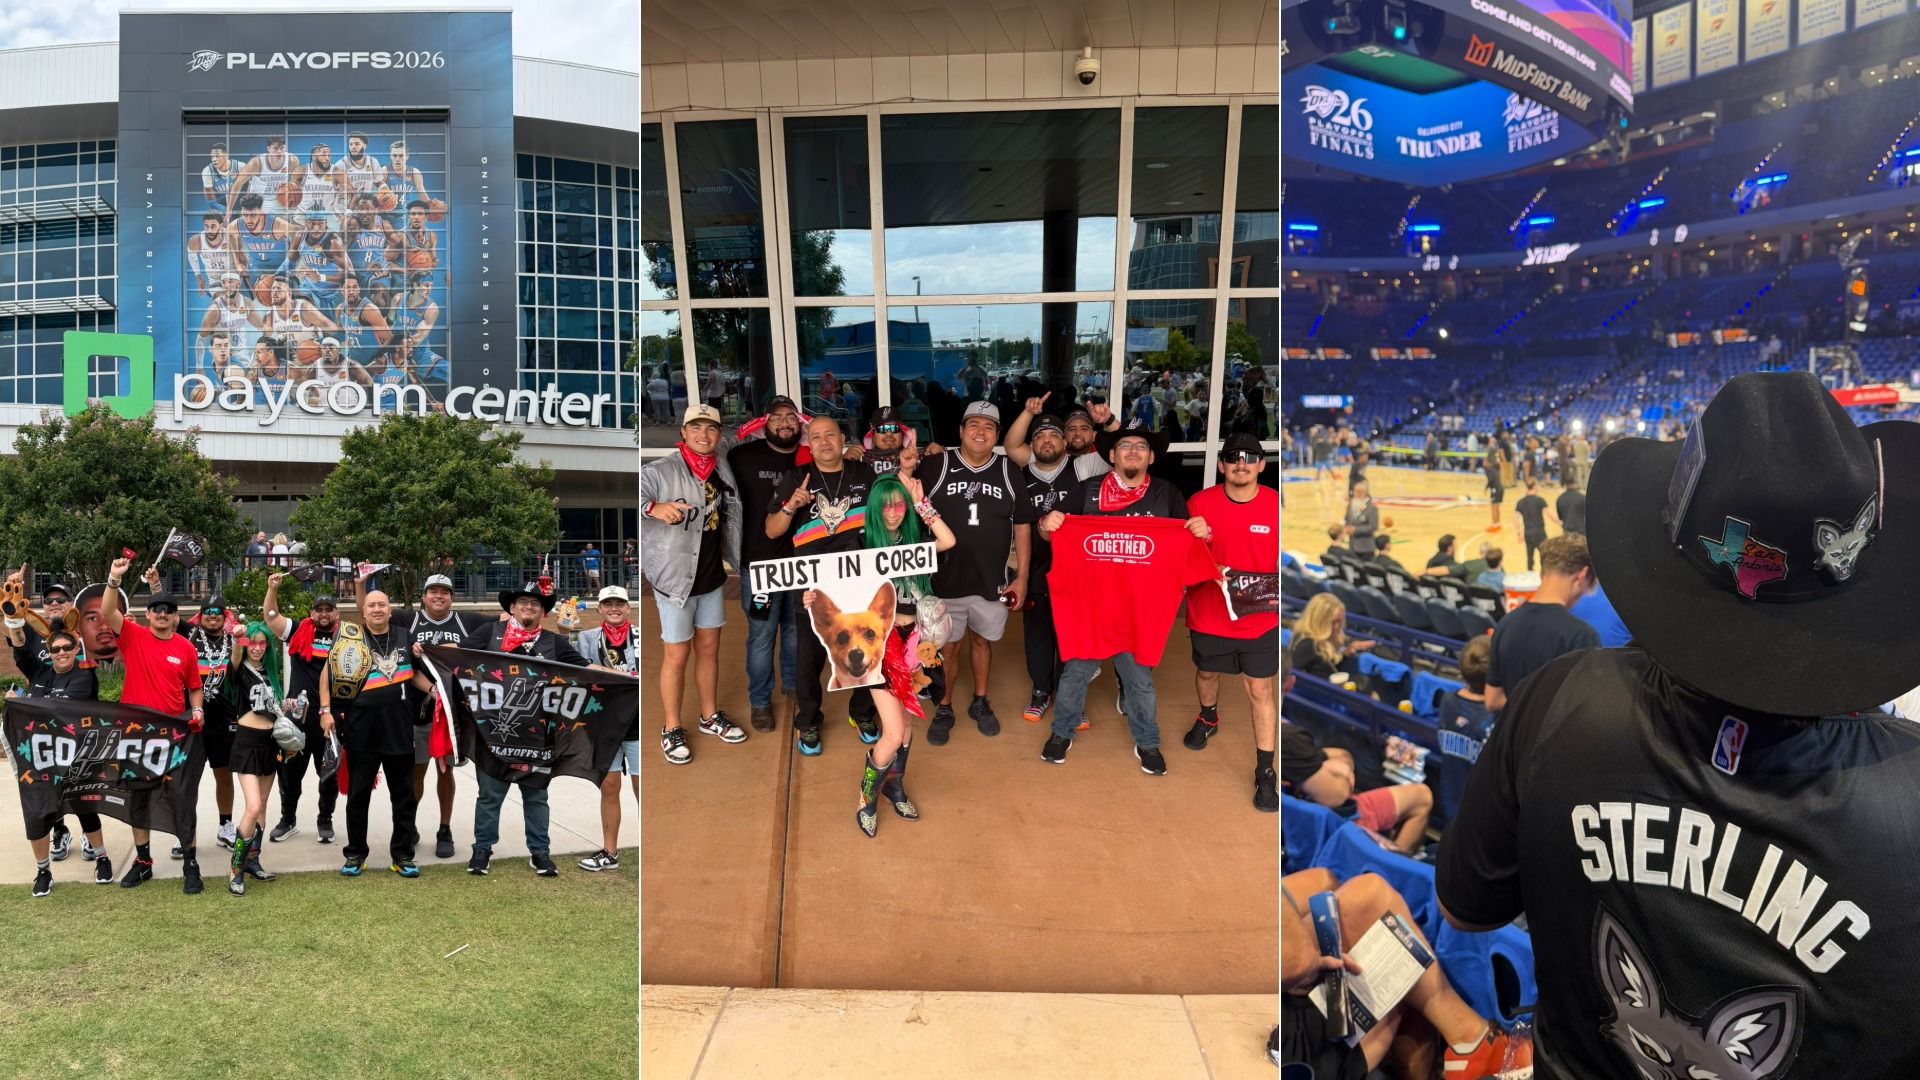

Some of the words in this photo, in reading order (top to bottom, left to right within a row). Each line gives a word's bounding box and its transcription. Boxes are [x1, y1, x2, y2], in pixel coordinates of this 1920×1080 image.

[1471, 0, 1507, 22] COME
[1508, 12, 1532, 33] AND
[1532, 26, 1553, 43] GET
[1552, 35, 1576, 58] YOUR
[226, 52, 392, 69] PLAYOFFS
[392, 51, 445, 69] 2026
[1331, 89, 1374, 131] 26
[1308, 116, 1373, 141] PLAYOFFS
[1310, 131, 1375, 160] FINALS
[1396, 131, 1483, 159] THUNDER
[1508, 125, 1559, 153] FINALS
[146, 173, 154, 234] GIVEN
[481, 156, 490, 287] EVERYTHING
[482, 304, 490, 351] GIVE
[174, 371, 428, 426] paycom
[444, 382, 611, 428] center
[967, 503, 980, 526] 1
[1091, 539, 1147, 555] TOGETHER
[1103, 532, 1135, 540] Better
[750, 558, 821, 591] TRUST
[838, 553, 862, 579] IN
[875, 546, 933, 576] CORGI
[542, 685, 587, 720] GO
[31, 733, 78, 771] GO
[1570, 801, 1871, 974] STERLING
